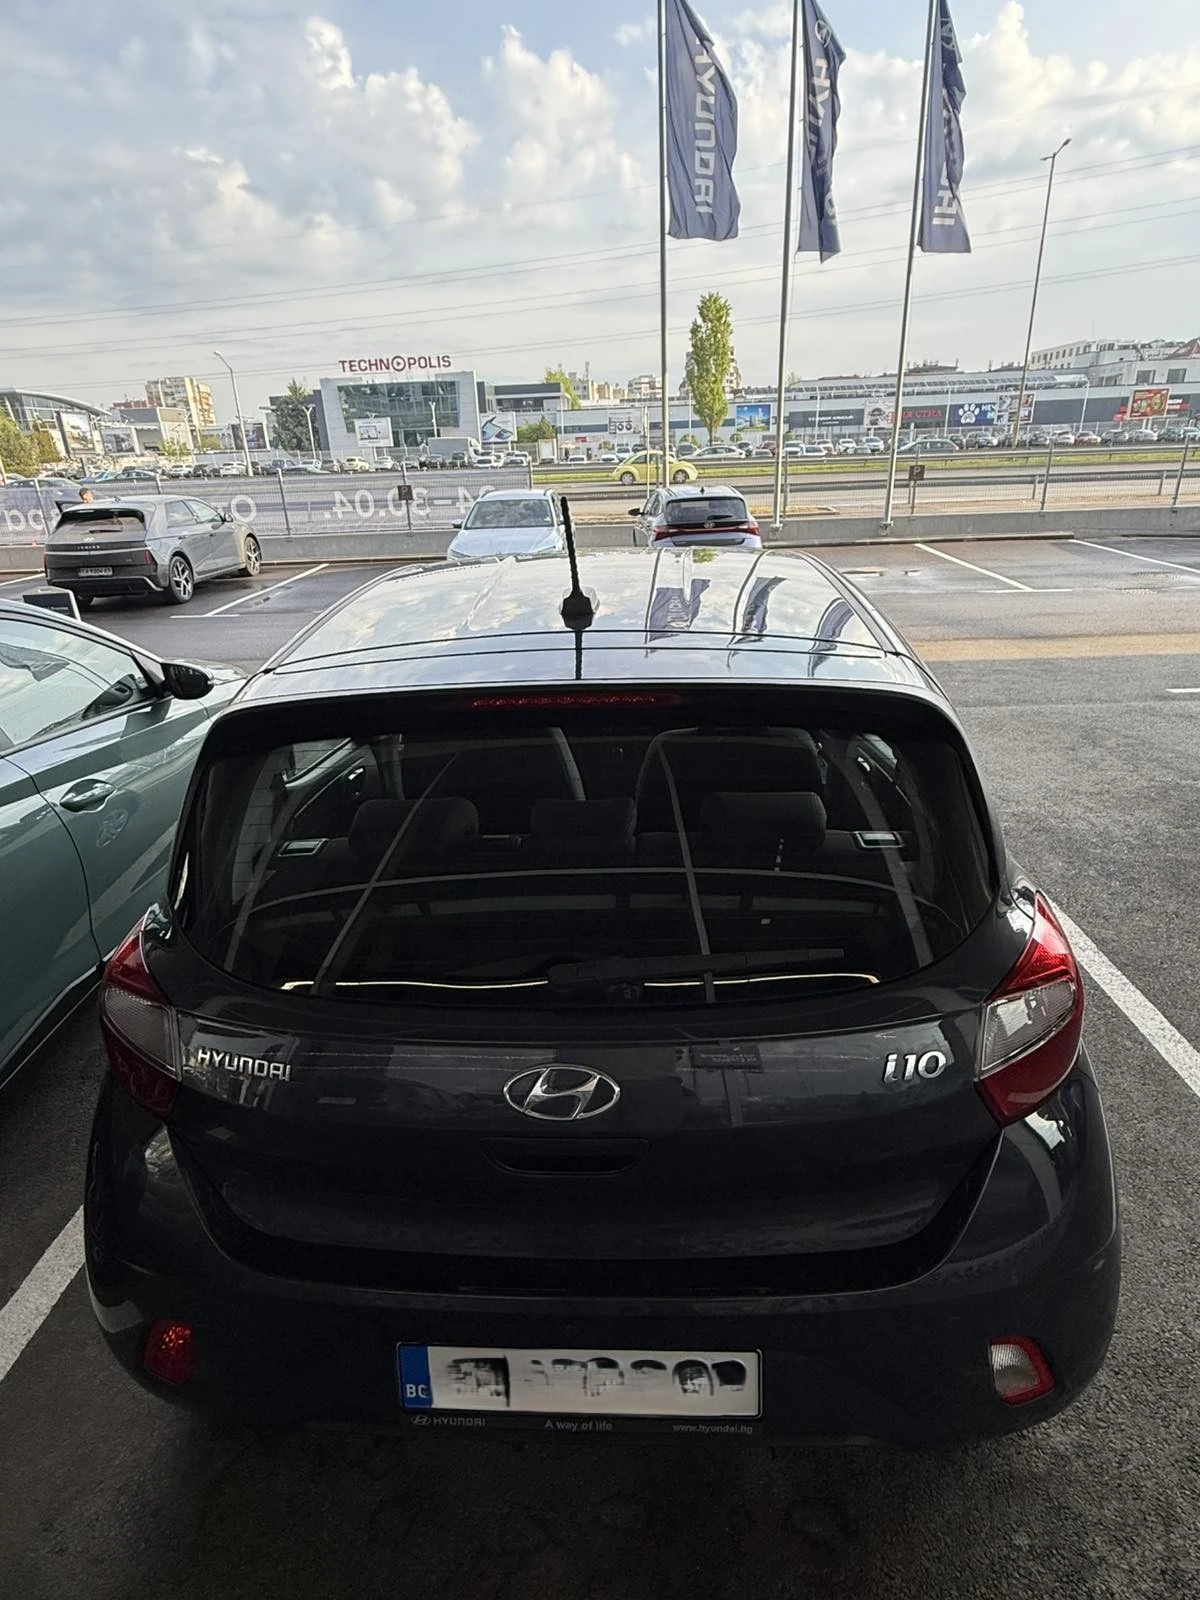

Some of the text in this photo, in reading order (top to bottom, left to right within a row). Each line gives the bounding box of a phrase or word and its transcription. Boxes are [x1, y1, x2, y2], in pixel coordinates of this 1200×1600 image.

[338, 355, 452, 373] TECHNOPOLIS
[197, 1048, 290, 1081] HYUNDAI
[433, 1417, 486, 1427] HYUNDAI
[544, 1419, 613, 1431] A way of life
[672, 1423, 753, 1434] www.hyundai.bg
